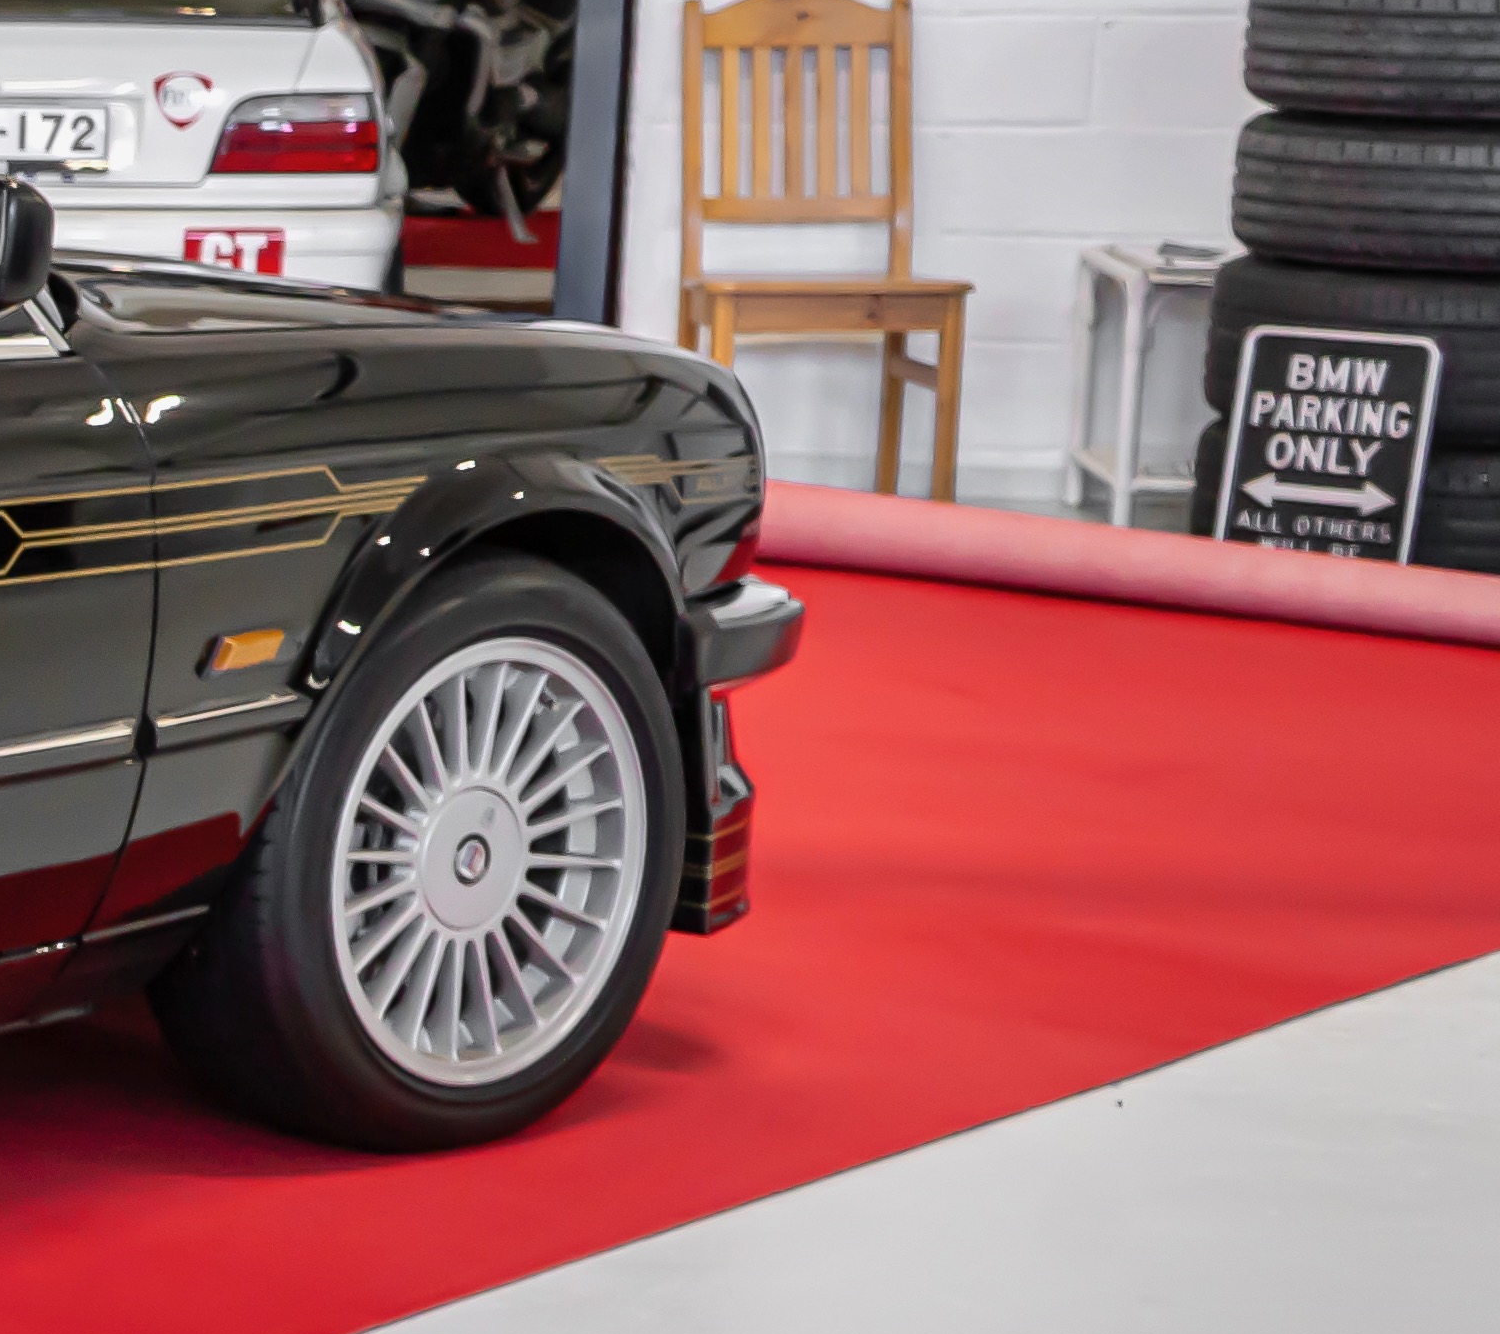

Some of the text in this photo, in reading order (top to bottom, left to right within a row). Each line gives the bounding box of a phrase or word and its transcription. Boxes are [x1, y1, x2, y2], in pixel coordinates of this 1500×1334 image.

[202, 231, 269, 275] GT
[1286, 353, 1388, 396] BMW
[1250, 390, 1413, 440] PARKING
[1265, 431, 1383, 476] ONLY
[1234, 508, 1393, 544] ALL OTHERS
